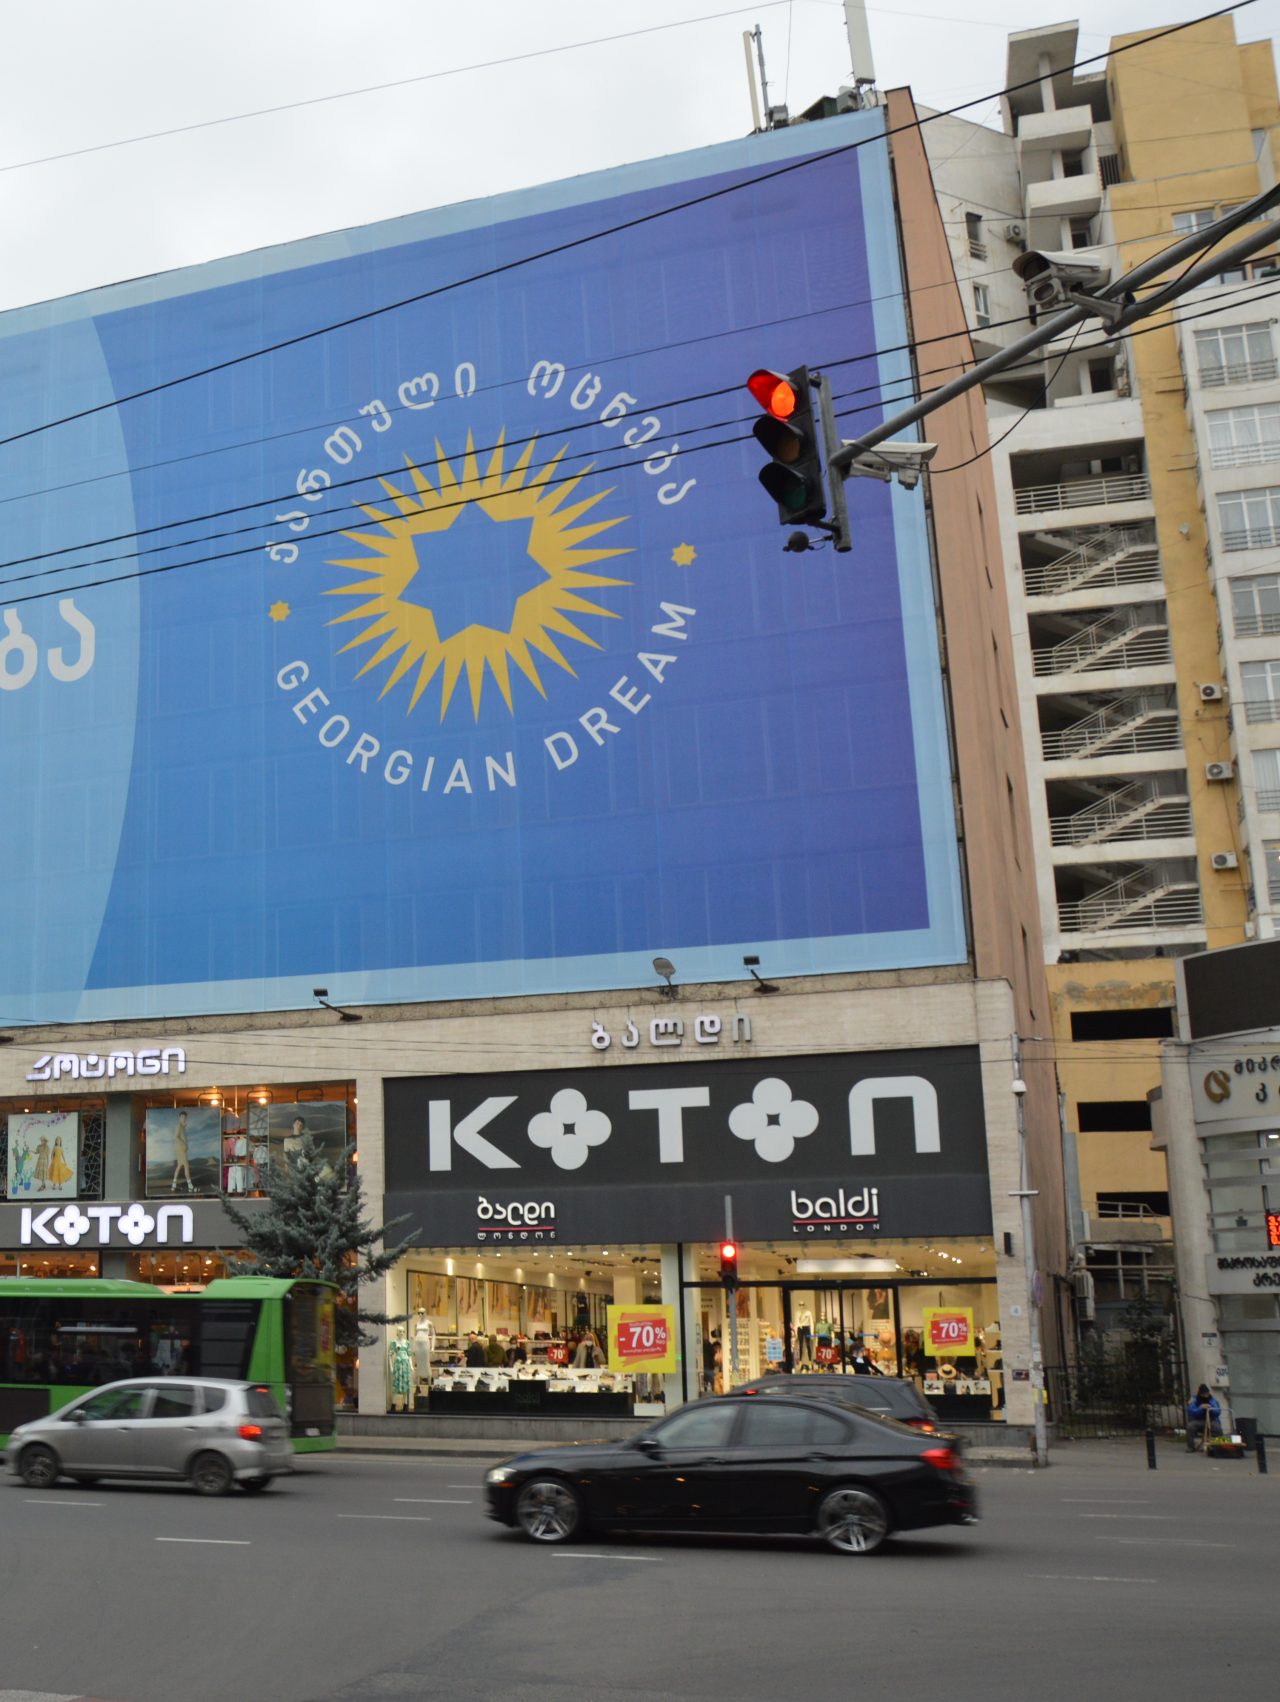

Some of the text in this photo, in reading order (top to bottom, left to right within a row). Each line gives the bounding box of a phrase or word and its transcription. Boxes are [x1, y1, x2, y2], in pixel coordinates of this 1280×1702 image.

[265, 359, 698, 565] ქართული ოცნება
[276, 600, 698, 795] GEORGIAN DREAM
[591, 1013, 752, 1050] ბალდი
[477, 1195, 556, 1226] ბალდი
[790, 1187, 879, 1219] baldi
[793, 1223, 880, 1233] LONDON
